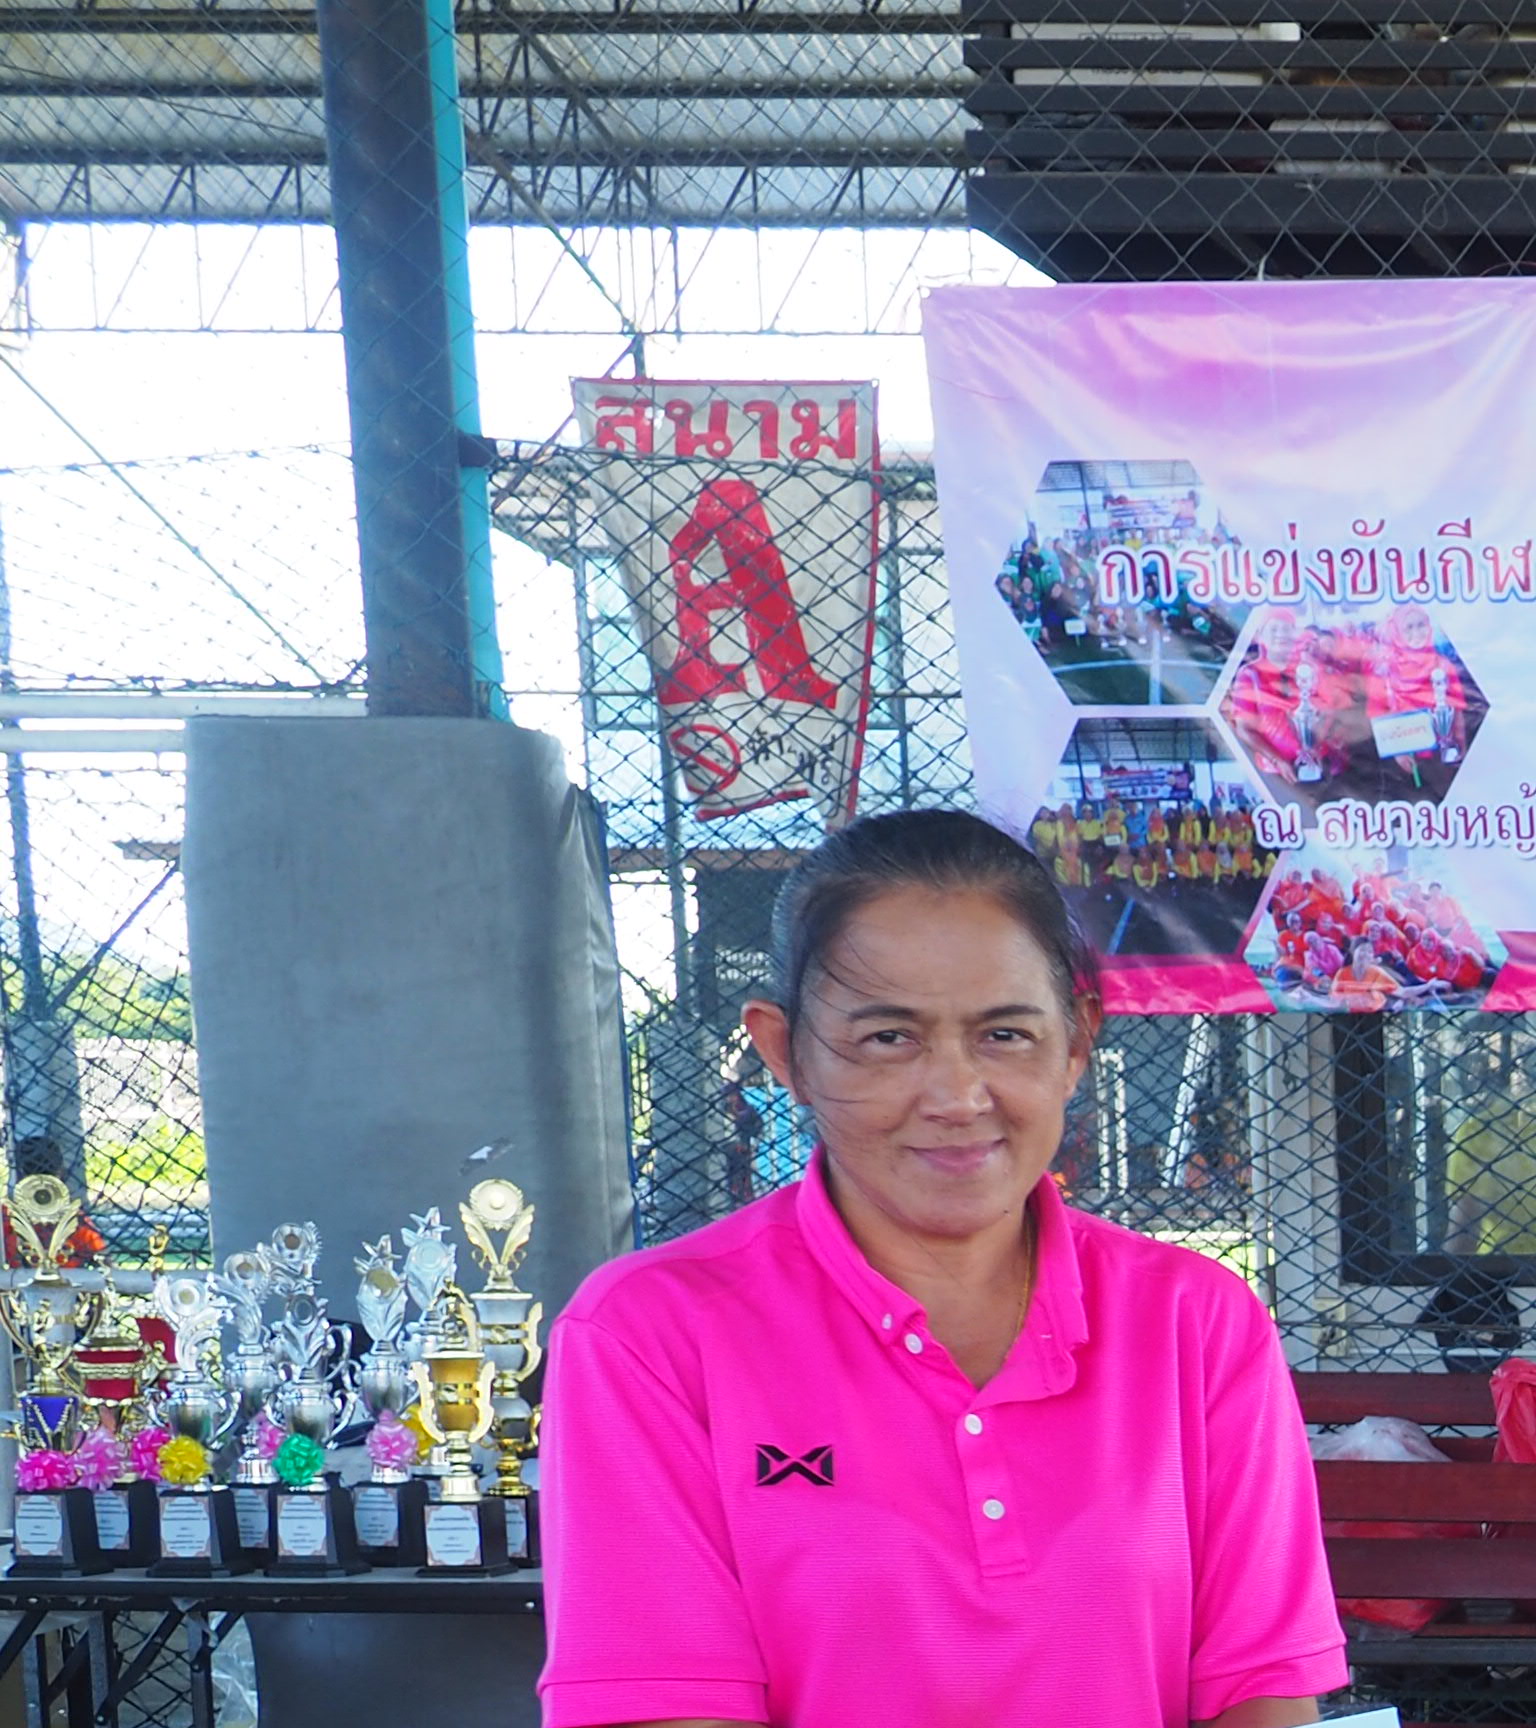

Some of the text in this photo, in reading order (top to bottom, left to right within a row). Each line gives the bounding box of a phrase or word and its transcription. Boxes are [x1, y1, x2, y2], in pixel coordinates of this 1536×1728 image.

[595, 397, 857, 460] สนาม
[656, 479, 838, 710] A
[1256, 805, 1299, 846] ณ
